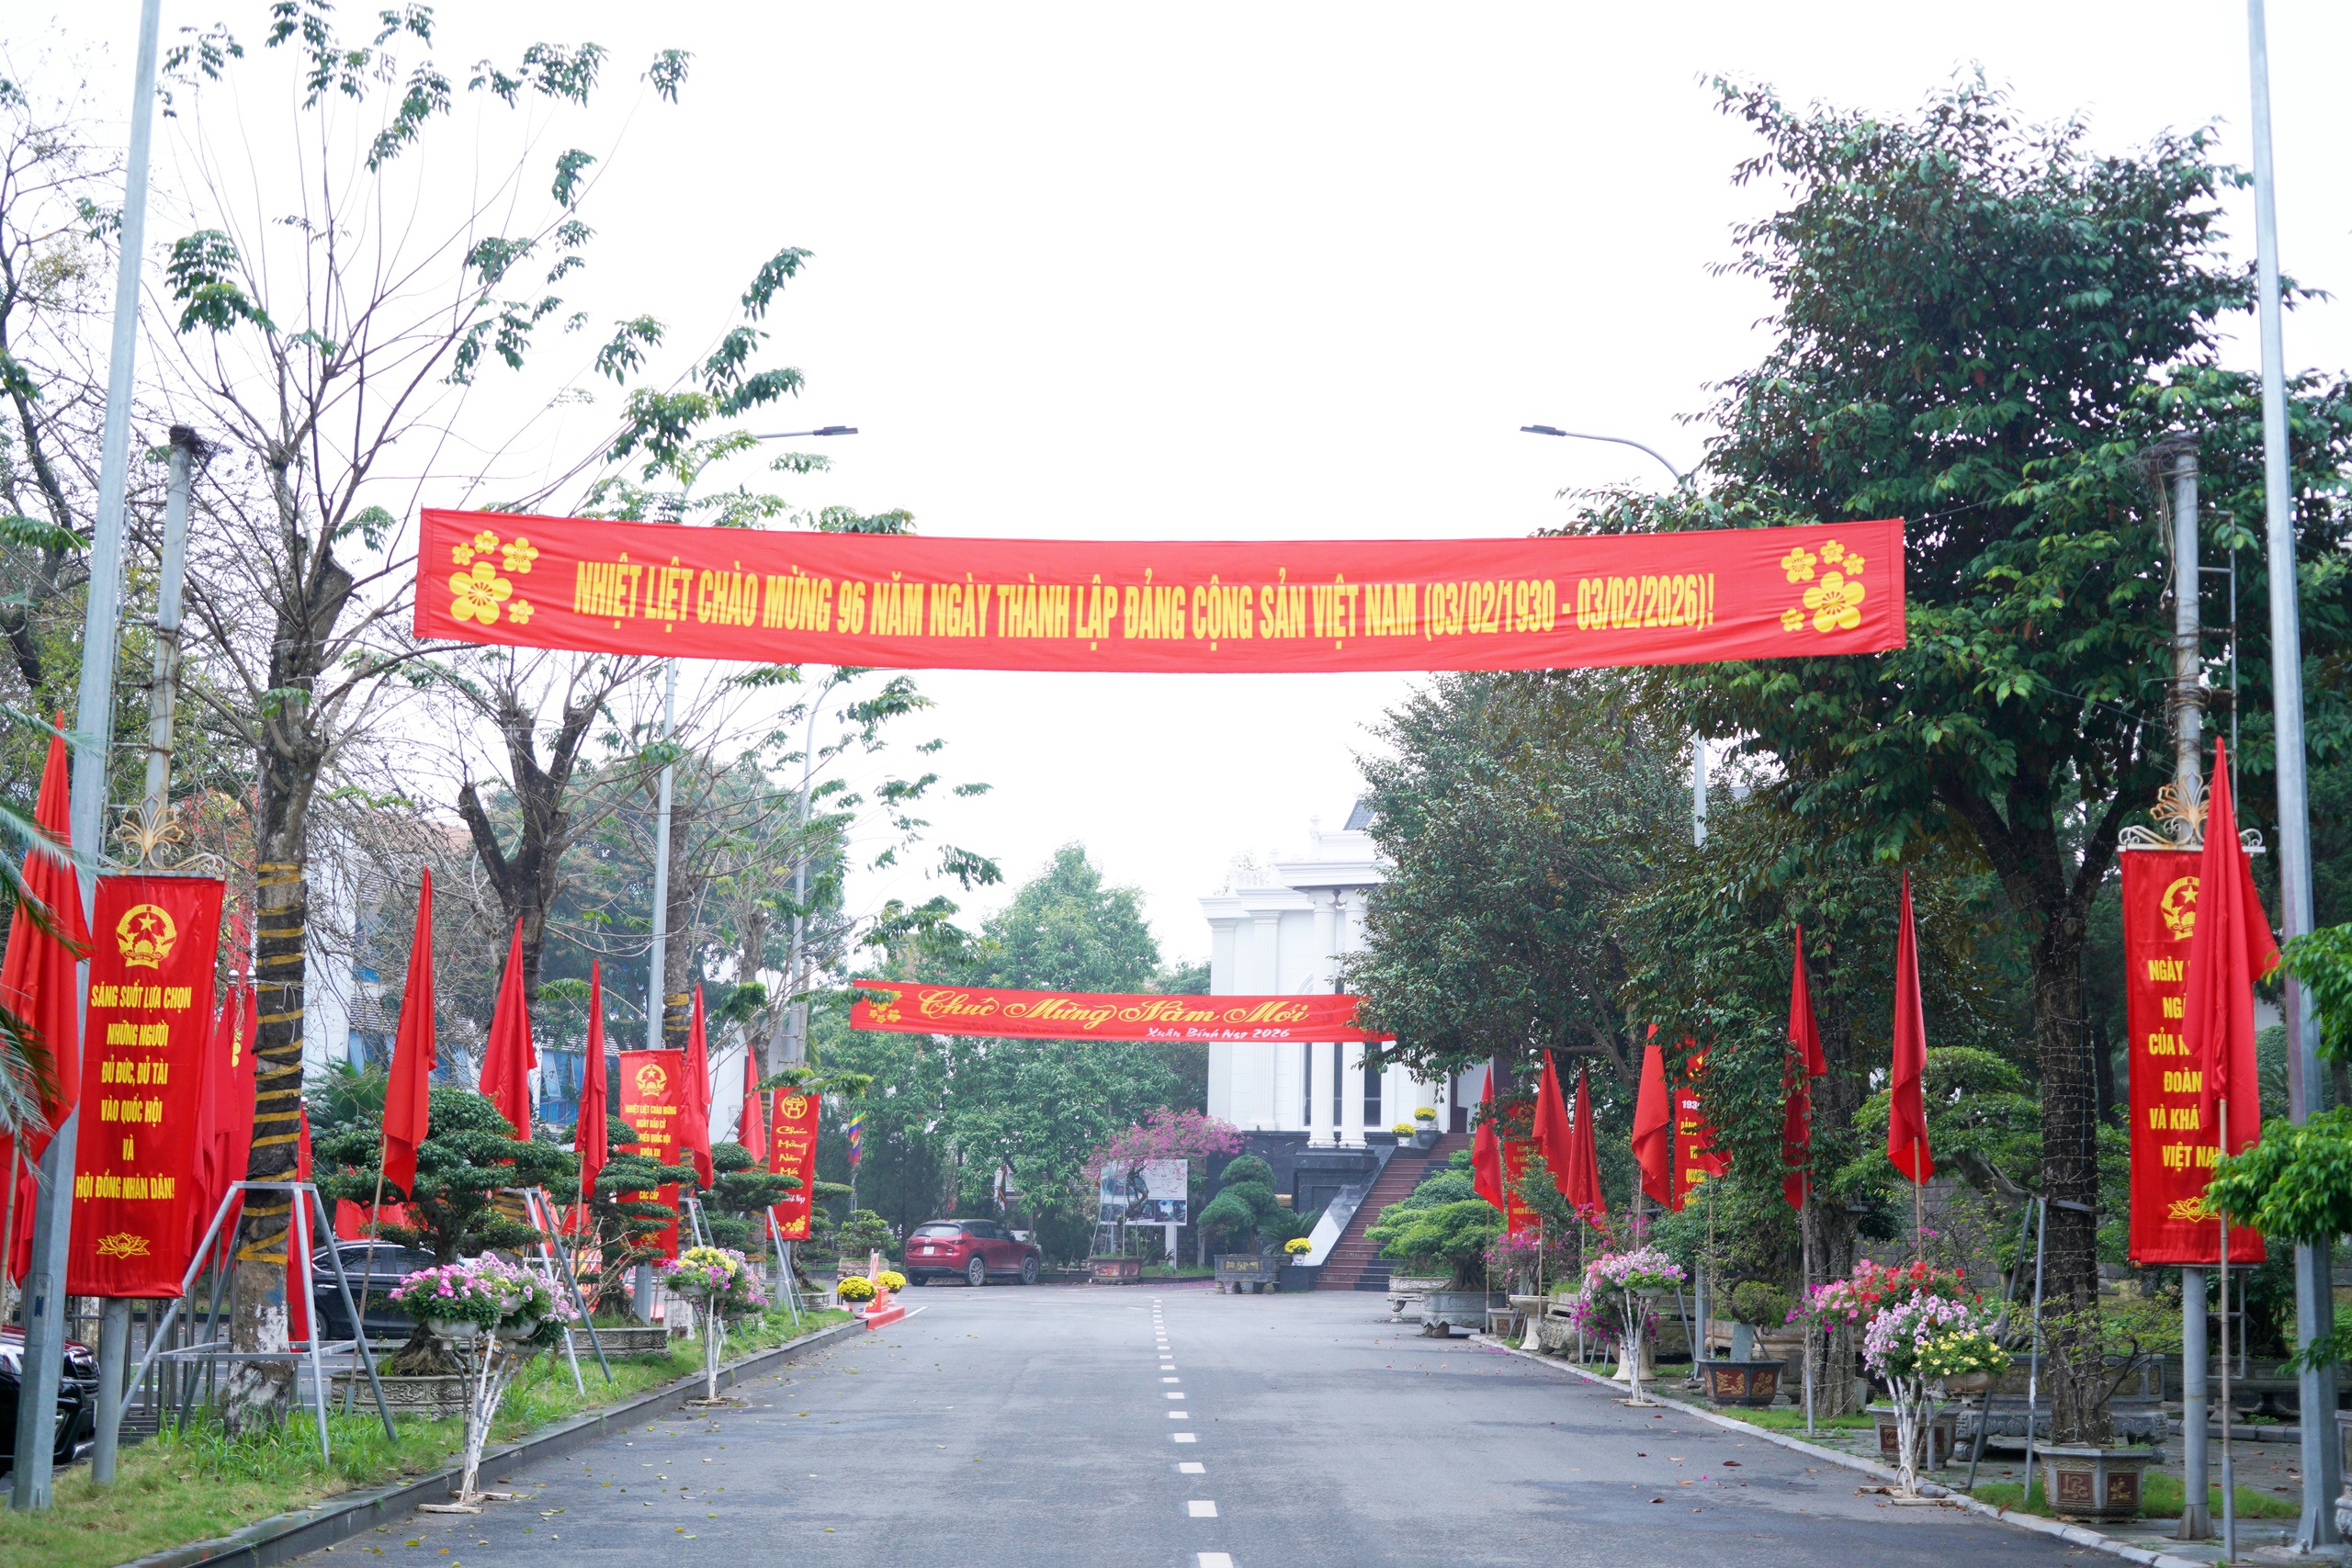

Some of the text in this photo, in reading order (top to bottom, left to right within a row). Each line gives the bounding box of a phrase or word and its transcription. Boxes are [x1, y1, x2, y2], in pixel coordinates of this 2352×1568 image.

[573, 552, 641, 629] NHIỆT
[645, 556, 695, 634] LIỆT
[696, 560, 757, 628] CHÀO
[762, 564, 832, 632] MỪNG
[836, 580, 865, 635] 96
[869, 572, 923, 637] NĂM
[930, 572, 991, 637] NGÀY
[997, 573, 1070, 639] THÀNH
[1076, 574, 1119, 651] LẬP
[1124, 567, 1186, 641] ĐẢNG
[1193, 575, 1253, 651] CỘNG
[1260, 567, 1306, 639] SẢN
[1313, 573, 1360, 650] VIỆT
[1364, 583, 1417, 637] NAM
[1423, 579, 1556, 641] (03/02/1930
[1576, 572, 1715, 631] 03/02/2026)!
[2148, 956, 2184, 981] NGÀY
[91, 979, 192, 1013] SÁNG SUỐT LỰA CHỌN
[917, 989, 1001, 1021] Chúc
[1005, 998, 1118, 1030] Mừng
[1119, 999, 1222, 1023] Năm
[1223, 999, 1310, 1023] Mới
[107, 1020, 169, 1046] NHỮNG NGƯỜI
[1146, 1027, 1181, 1038] Xuân
[1186, 1027, 1220, 1039] Bính
[1251, 1028, 1291, 1039] 2026
[2149, 1027, 2176, 1055] CỦA
[101, 1055, 168, 1086] ĐỦ ĐỨC, ĐỦ TÀI
[2164, 1067, 2201, 1092] ĐOÀN
[101, 1093, 163, 1127] VÀO QUỐC HỘI
[2150, 1104, 2166, 1130] VÀ
[122, 1134, 134, 1160] VÀ
[2163, 1142, 2192, 1171] VIỆT
[75, 1168, 175, 1202] HỘI ĐỒNG NHÂN DÂN!
